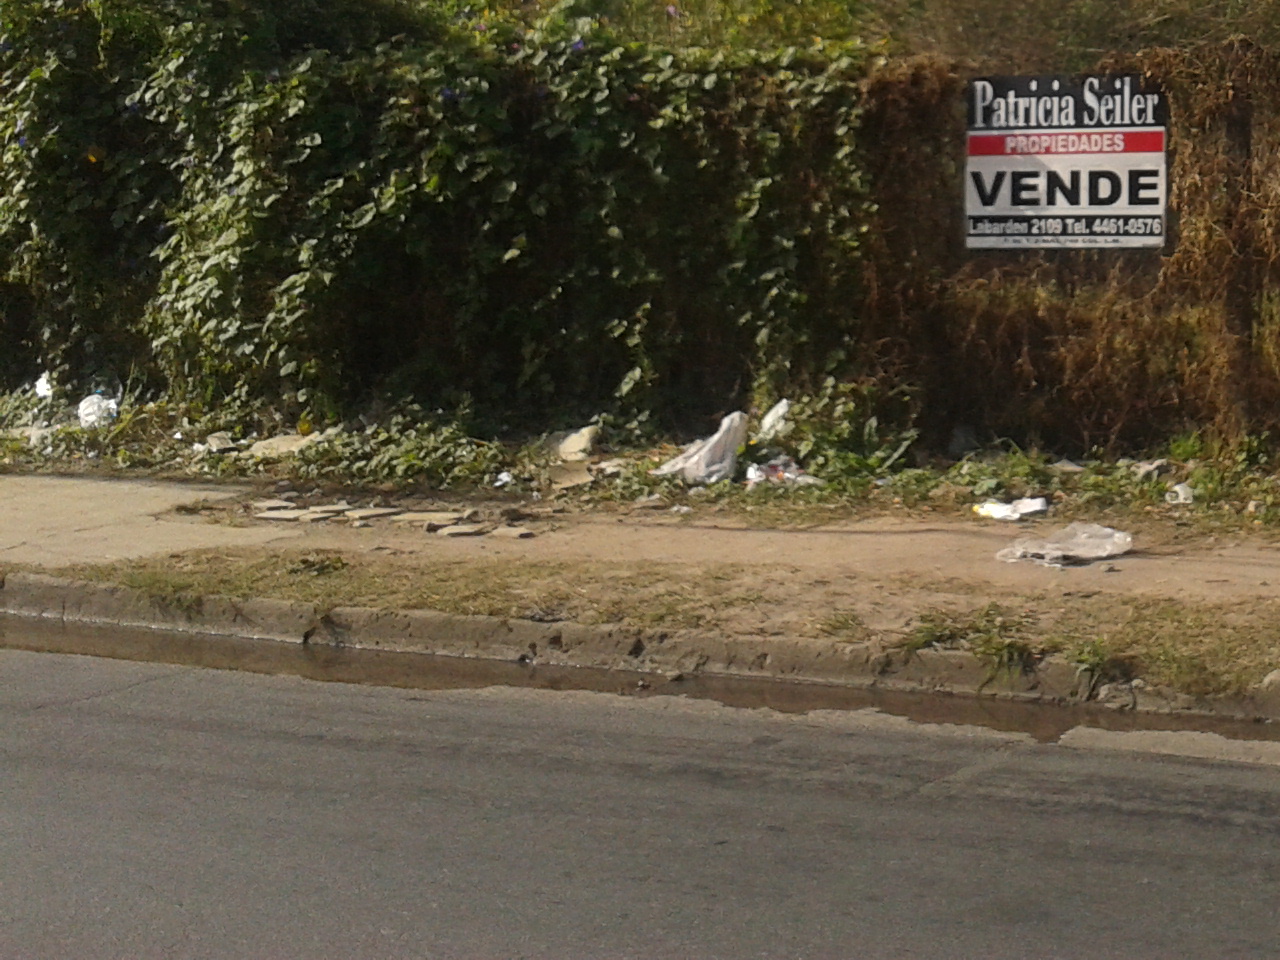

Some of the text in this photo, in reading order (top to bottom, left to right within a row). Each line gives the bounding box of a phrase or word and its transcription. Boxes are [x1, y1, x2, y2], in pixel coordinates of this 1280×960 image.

[973, 76, 1159, 128] Patricia Seiler
[1004, 133, 1125, 154] PROPIEDADES
[970, 169, 1160, 207] VENDE
[1065, 218, 1089, 234] Tel.
